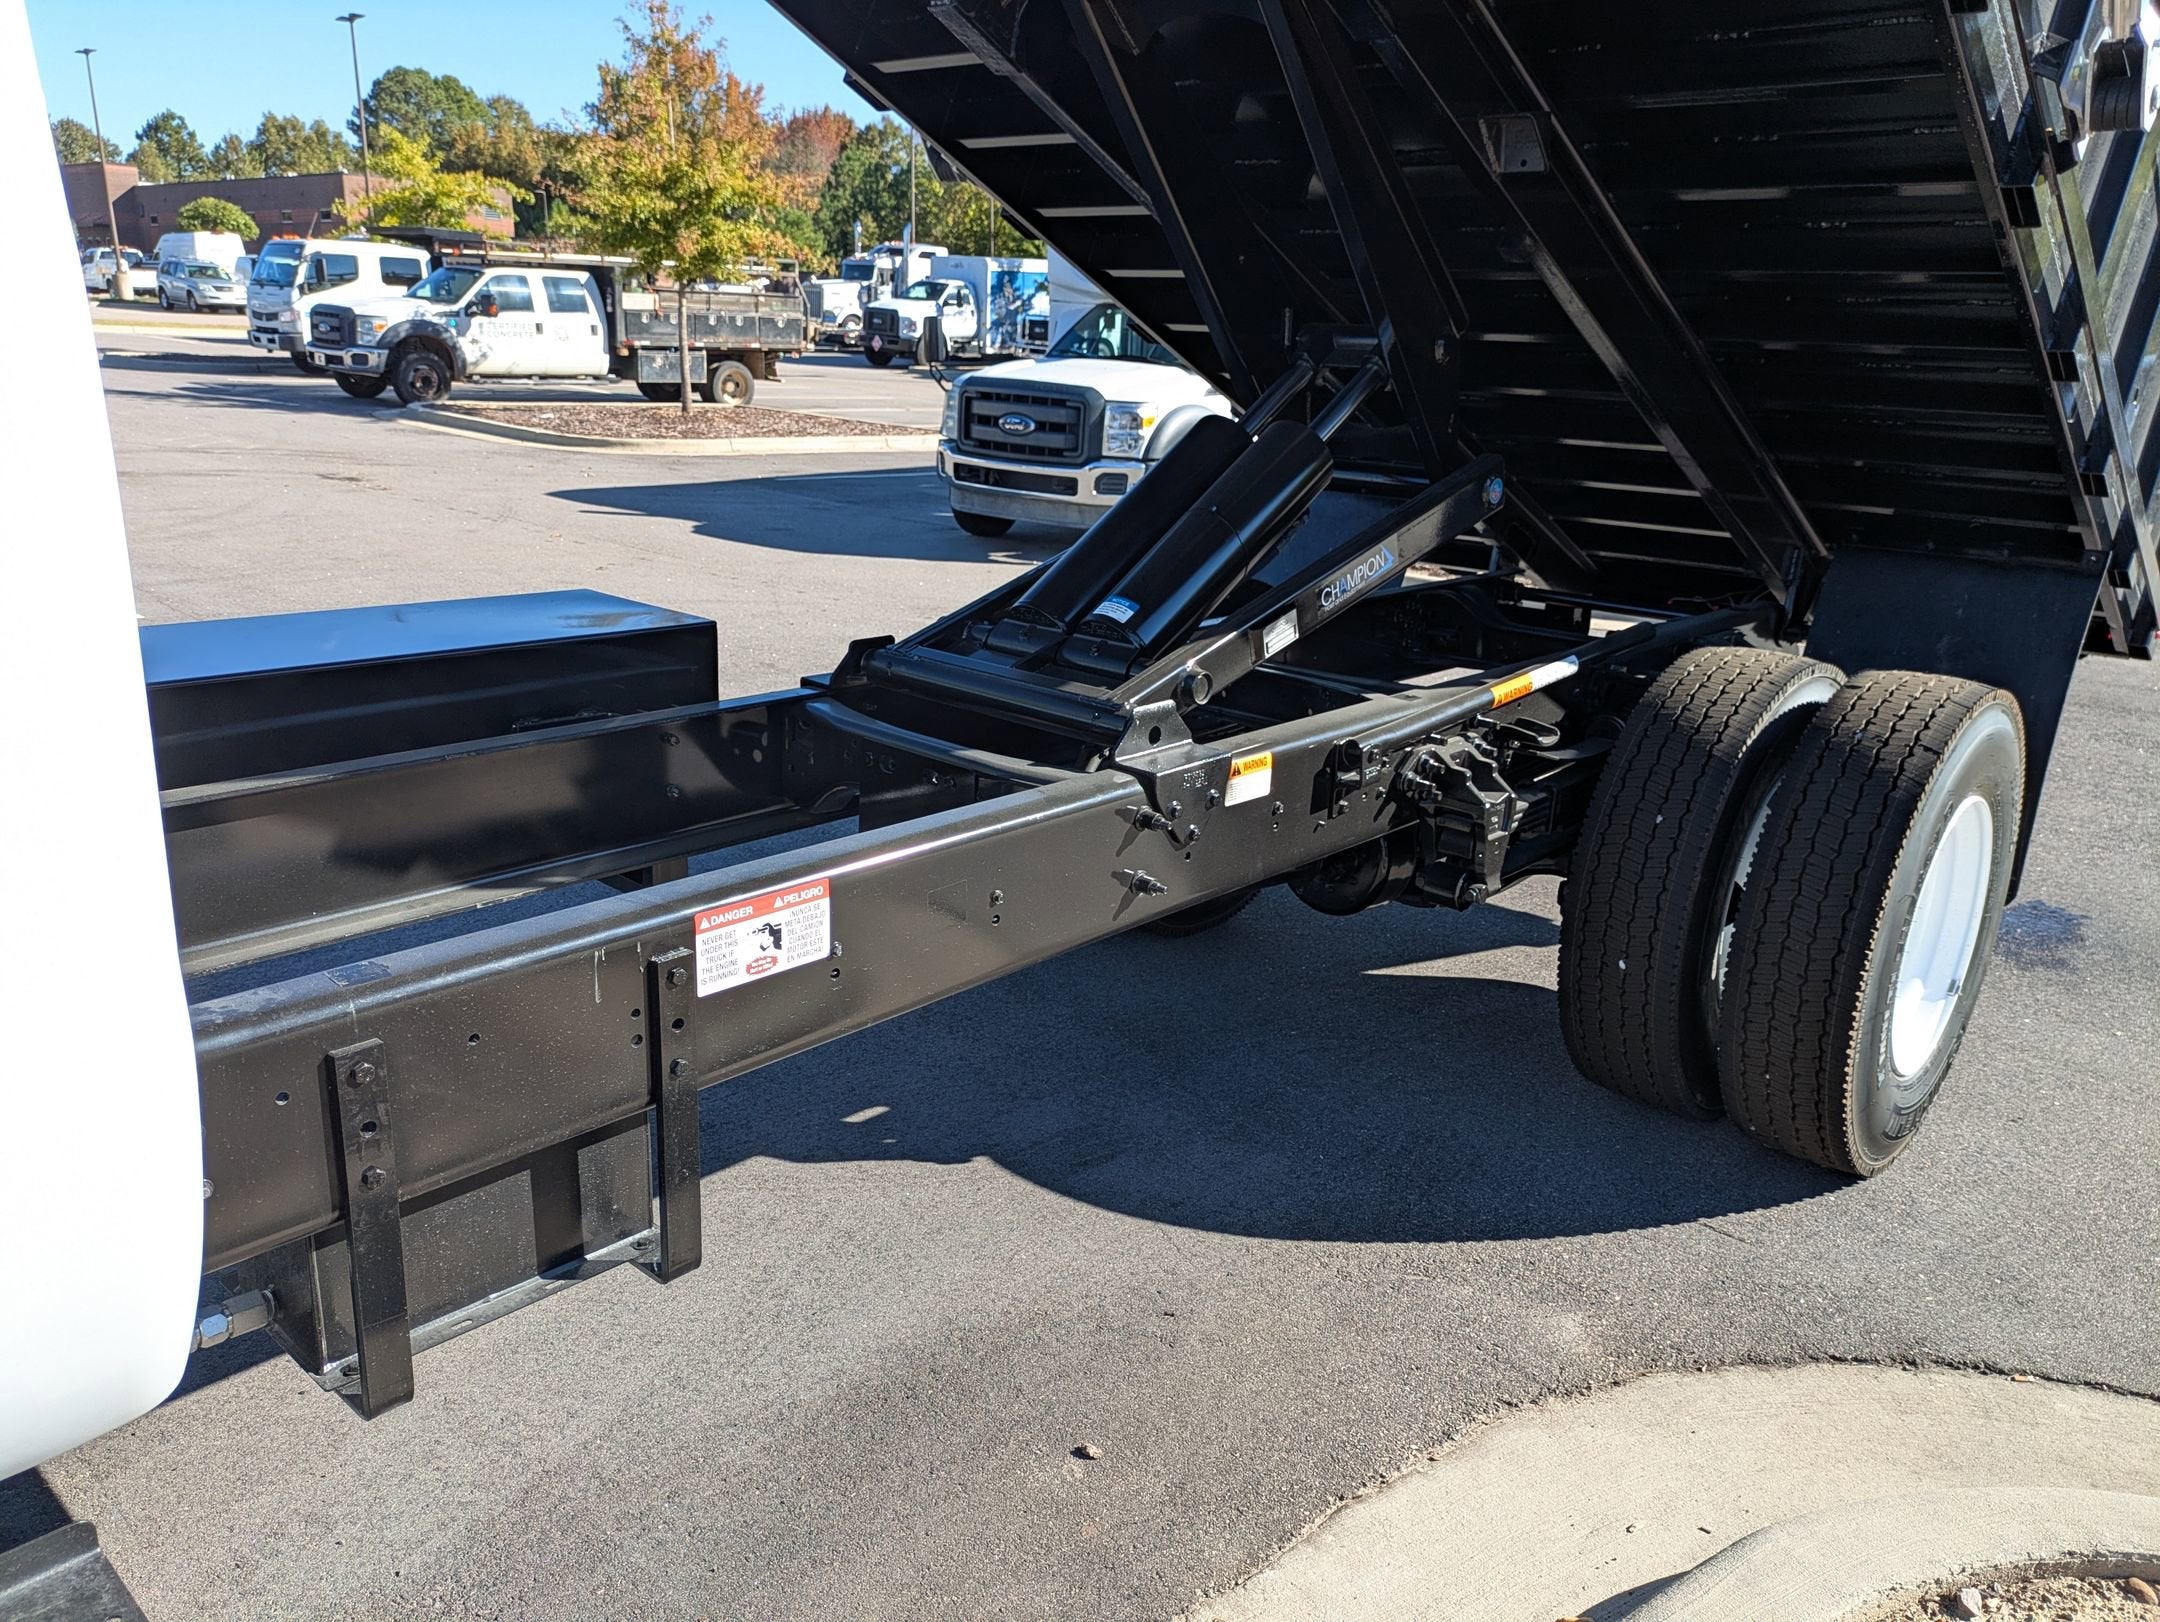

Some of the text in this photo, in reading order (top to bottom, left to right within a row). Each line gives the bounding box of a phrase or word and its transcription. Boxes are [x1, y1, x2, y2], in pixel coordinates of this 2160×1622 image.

[1321, 551, 1385, 606] CHAMPION
[1503, 681, 1533, 701] WARNING
[1243, 756, 1268, 772] WARNING
[783, 885, 824, 905] PELIGRO
[710, 905, 753, 926] DANGER
[813, 903, 821, 911] SE
[784, 910, 826, 927] META DEBAJO
[702, 929, 737, 946] NEVER GET
[787, 928, 798, 937] DEL
[789, 929, 822, 945] CUANDO EL
[700, 939, 738, 957] UNDER THIS
[787, 942, 808, 954] MOTOR
[706, 949, 735, 965] TRUCK IF
[787, 955, 795, 963] EN
[702, 966, 714, 976] THE
[716, 959, 739, 972] ENGINE
[701, 977, 708, 986] IS
[709, 967, 740, 983] RUNNING!
